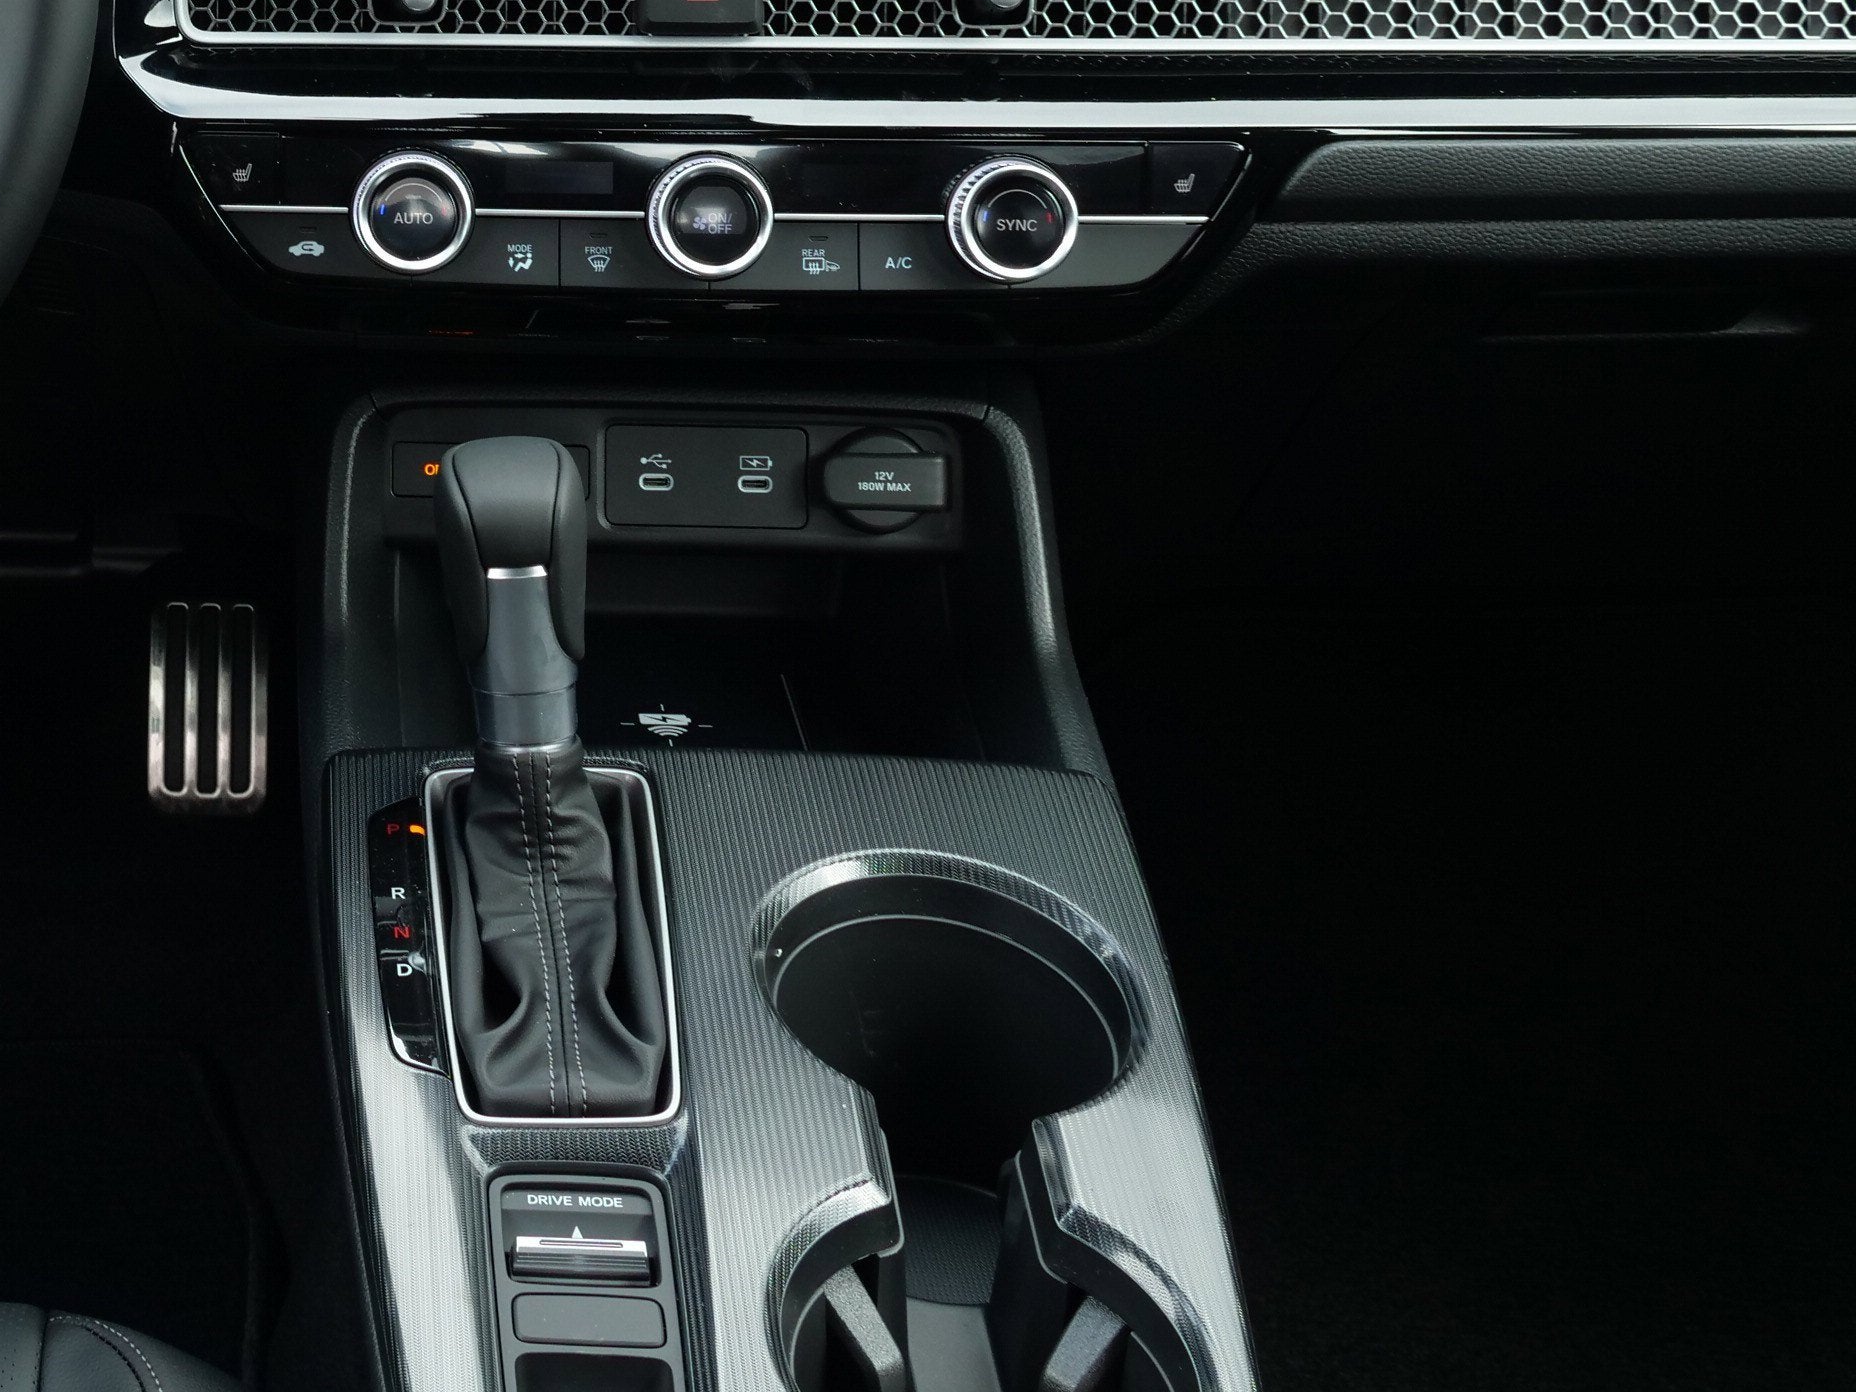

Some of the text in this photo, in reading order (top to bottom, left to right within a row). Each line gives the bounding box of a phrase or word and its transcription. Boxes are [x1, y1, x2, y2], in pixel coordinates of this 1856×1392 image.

[393, 212, 434, 225] AUTO
[708, 213, 733, 224] ON/
[708, 224, 733, 234] OFF
[995, 218, 1037, 232] SYNC
[507, 244, 533, 253] MODE
[584, 246, 614, 255] FRONT
[801, 248, 826, 257] REAR
[885, 257, 912, 269] A/C
[874, 471, 894, 481] 12V
[857, 481, 912, 492] 180W MAX
[386, 823, 400, 835] P
[390, 887, 406, 900] R
[394, 926, 411, 939] N
[396, 963, 413, 977] D
[527, 1194, 624, 1208] DRIVE MODE
